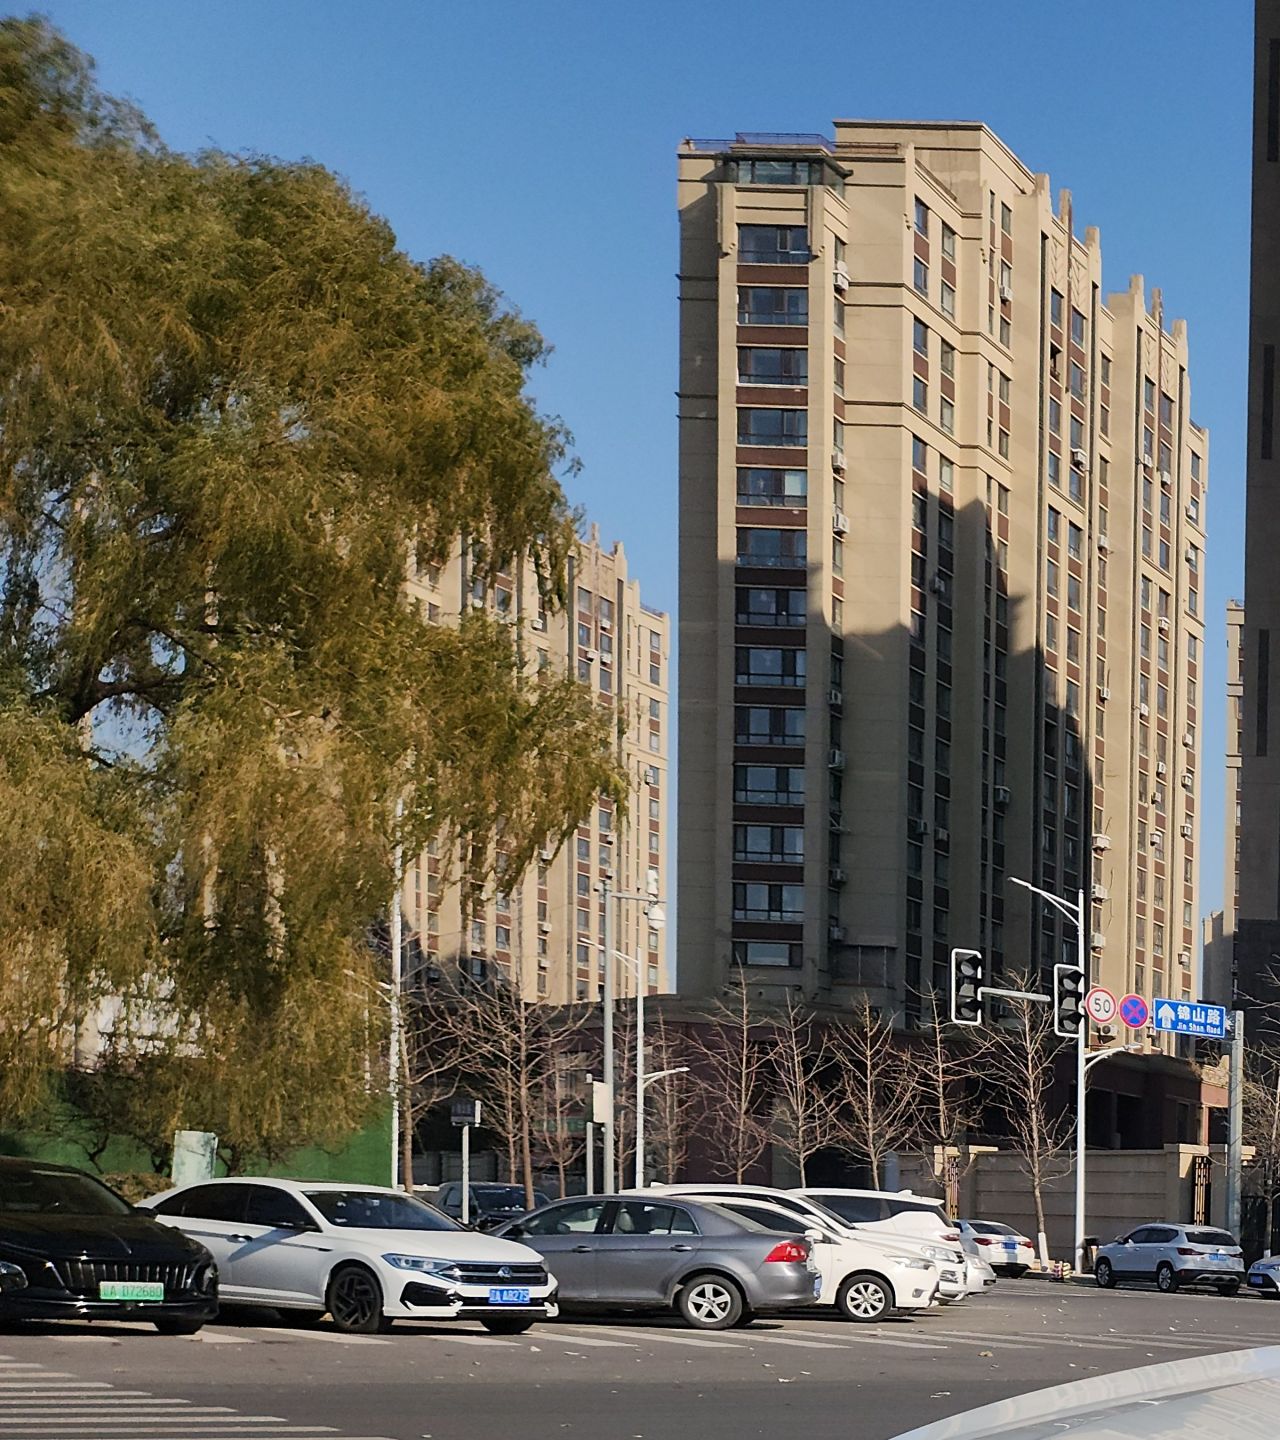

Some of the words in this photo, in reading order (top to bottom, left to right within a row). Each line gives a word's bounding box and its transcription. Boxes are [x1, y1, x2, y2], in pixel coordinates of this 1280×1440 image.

[1094, 997, 1111, 1014] 50
[1177, 1004, 1220, 1025] 锦山路
